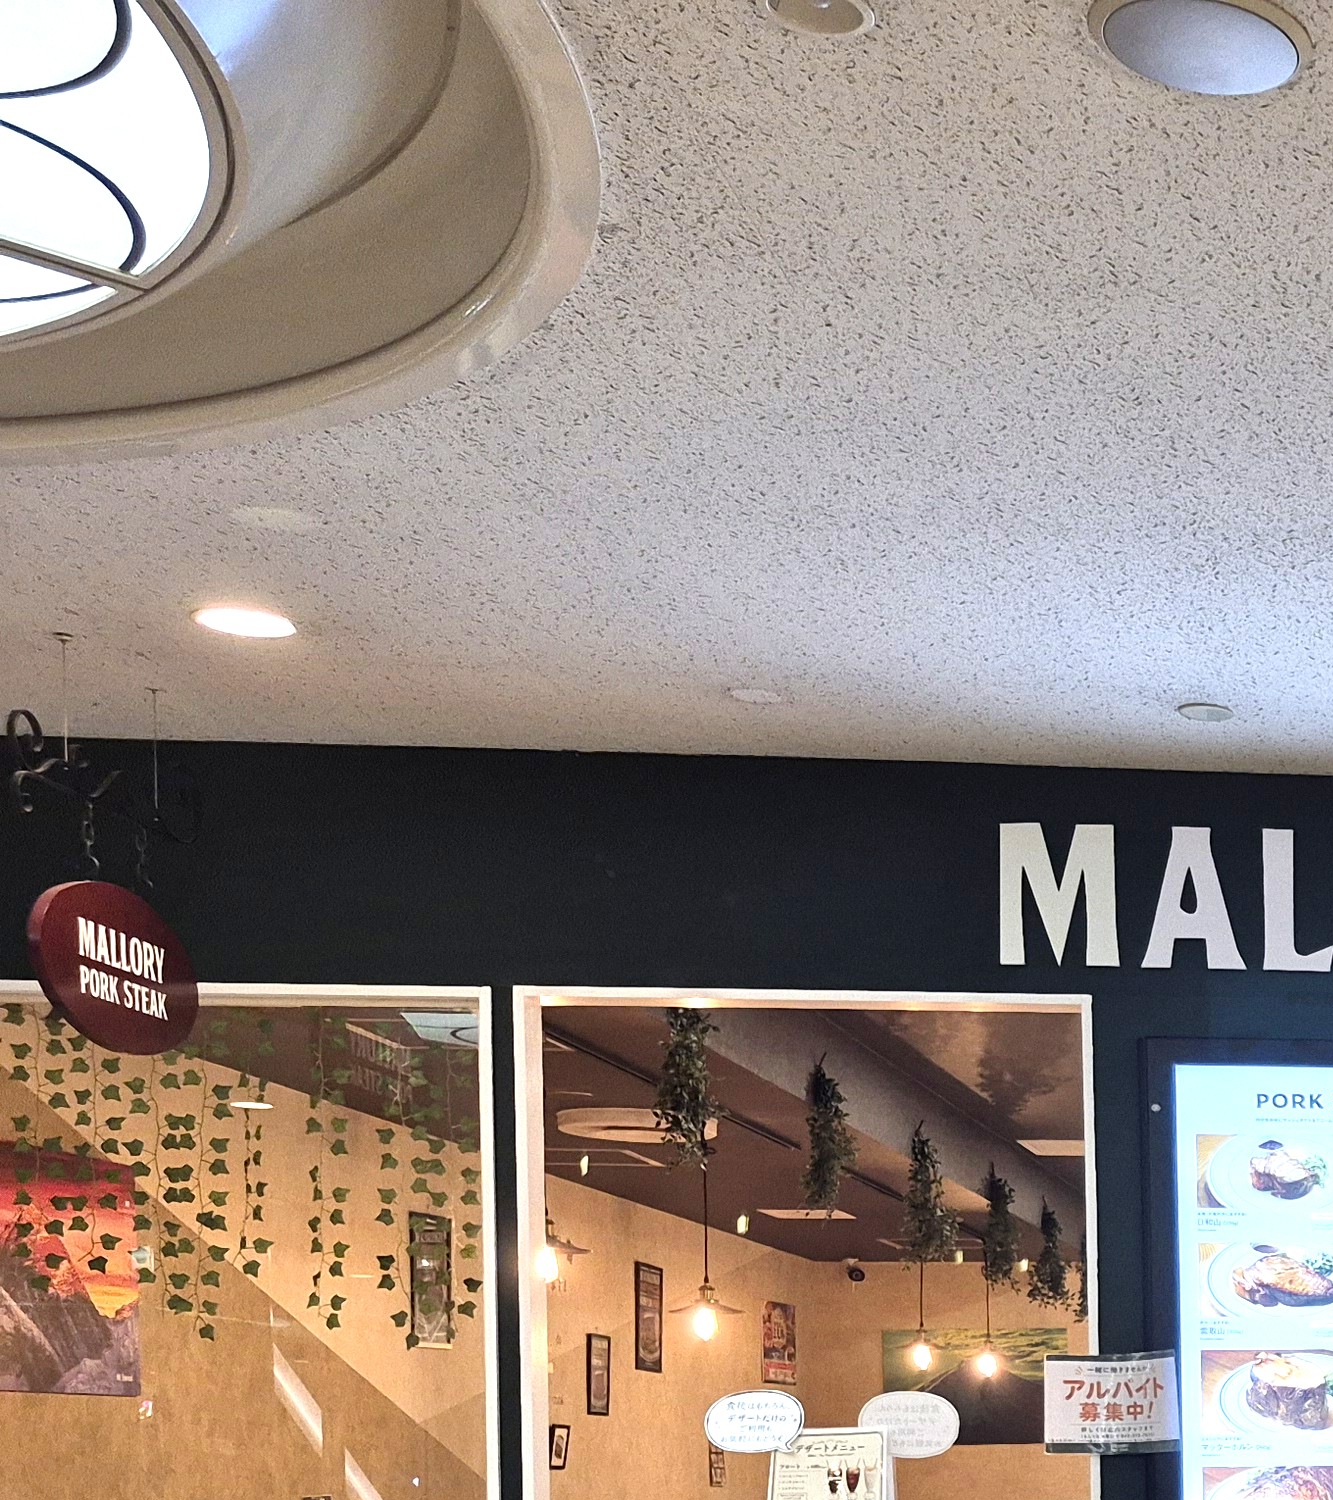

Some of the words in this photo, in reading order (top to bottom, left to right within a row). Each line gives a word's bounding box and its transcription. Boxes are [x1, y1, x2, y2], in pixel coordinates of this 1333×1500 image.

[77, 916, 165, 983] MALLORY
[79, 964, 120, 1005] PORK
[124, 980, 168, 1021] STEAK
[1256, 1093, 1323, 1109] PORK
[1062, 1377, 1164, 1400] アルバイト
[1079, 1401, 1154, 1422] 募集中!
